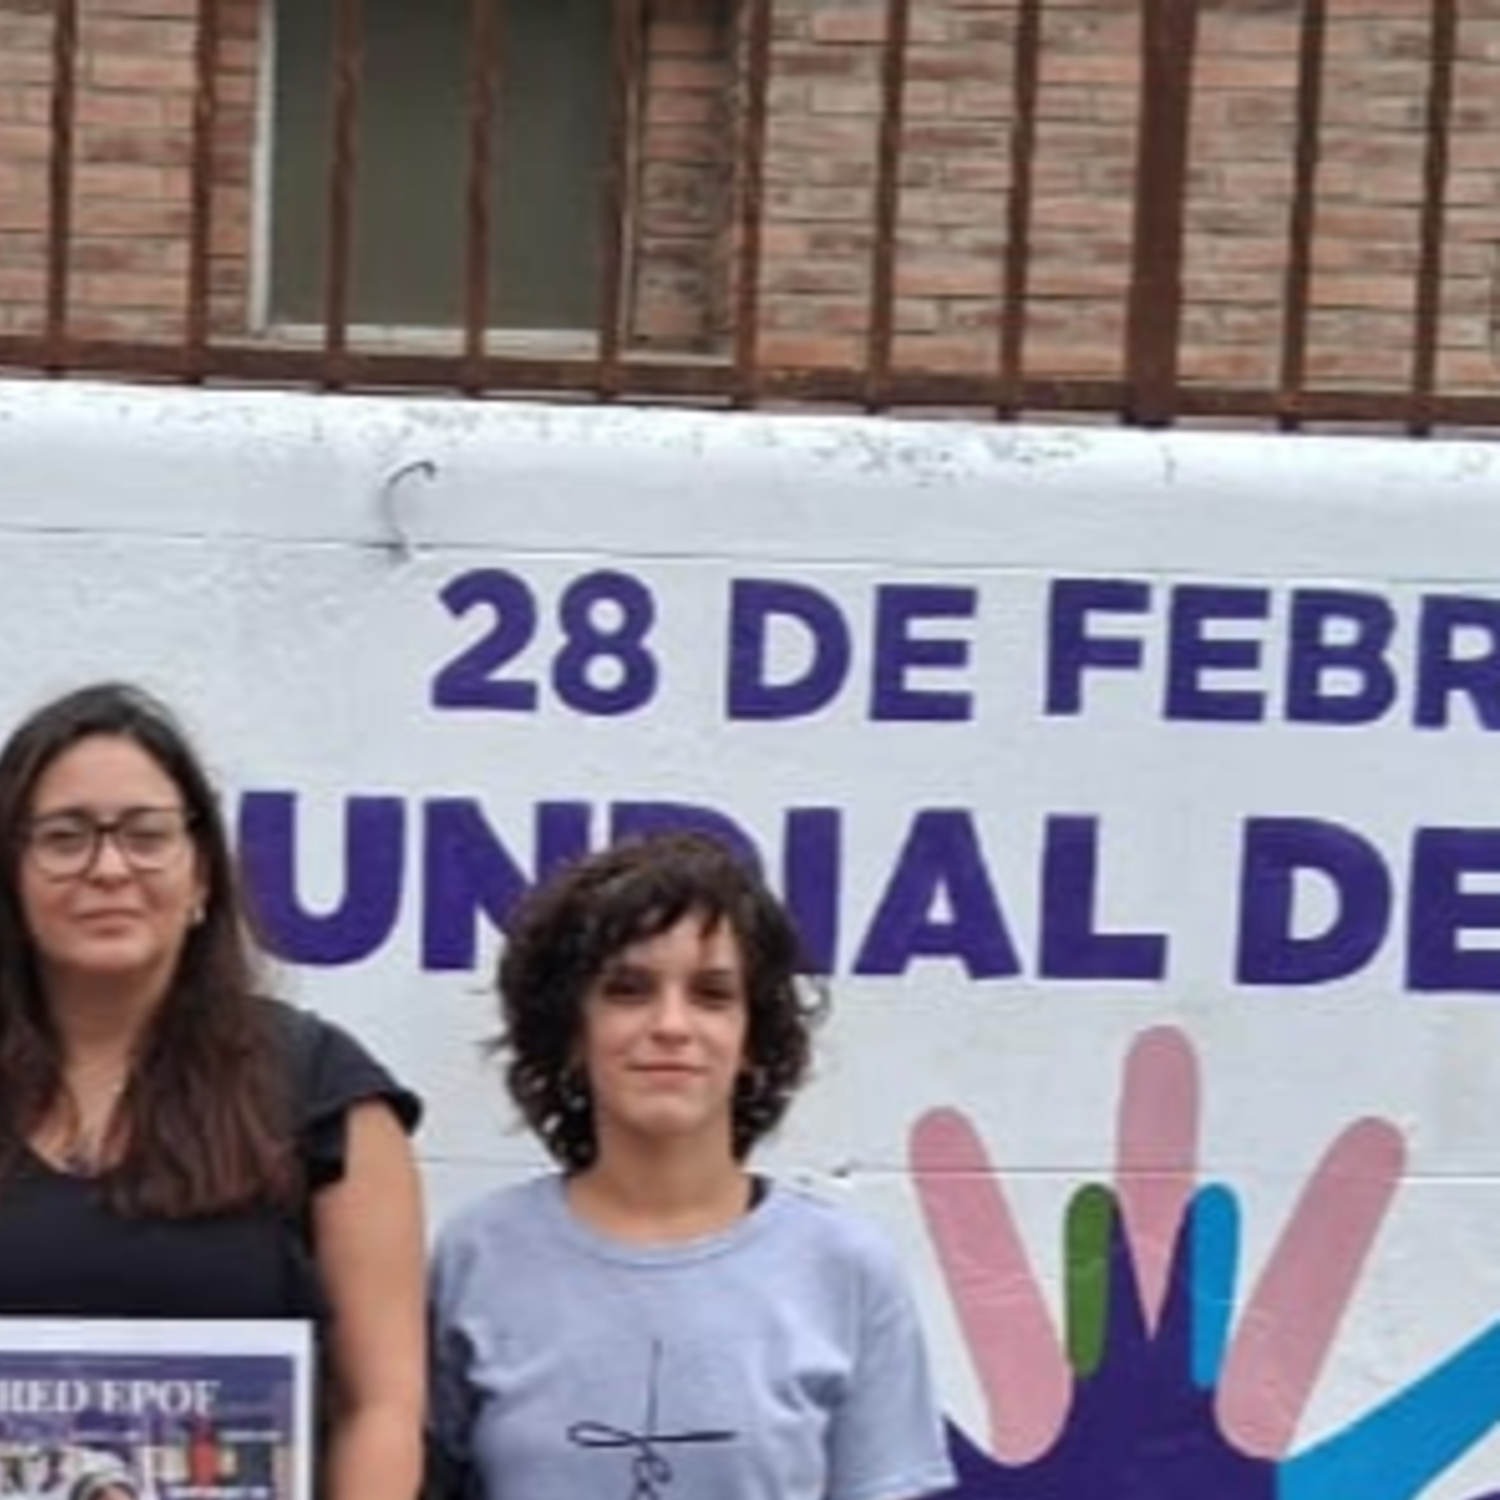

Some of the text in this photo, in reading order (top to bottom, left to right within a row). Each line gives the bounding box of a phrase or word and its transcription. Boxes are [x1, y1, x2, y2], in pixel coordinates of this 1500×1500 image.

[430, 566, 1500, 731] 28 DE FEBR
